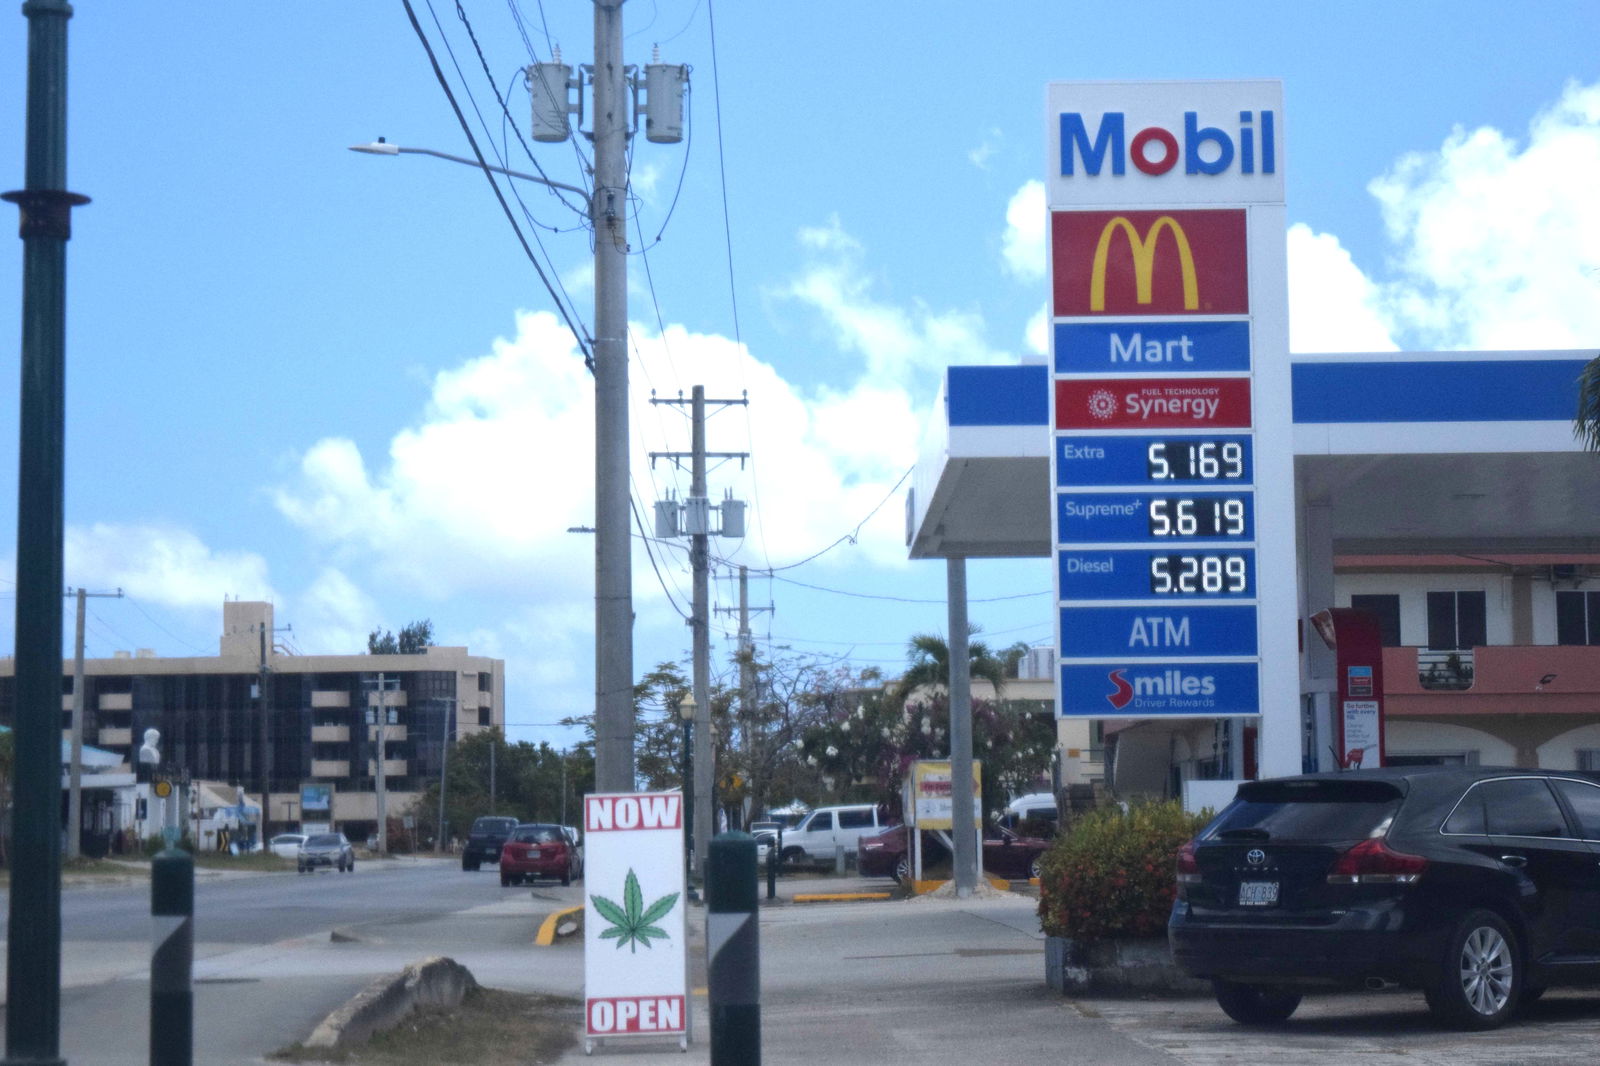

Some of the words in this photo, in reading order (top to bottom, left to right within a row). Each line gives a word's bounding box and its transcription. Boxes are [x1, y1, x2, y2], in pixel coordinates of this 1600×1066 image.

[1060, 110, 1275, 176] Mobil
[1110, 333, 1194, 362] Mart
[1126, 394, 1219, 419] Synergy
[1064, 445, 1105, 459] Extra
[1149, 443, 1243, 478] 5.169
[1150, 500, 1244, 535] 5.619
[1067, 558, 1113, 572] Diesel
[1152, 557, 1246, 593] 5.289
[1129, 617, 1190, 647] ATM
[1135, 698, 1166, 708] Driver
[1169, 698, 1215, 707] Rewards
[589, 796, 679, 829] NOW
[591, 999, 680, 1031] OPEN
